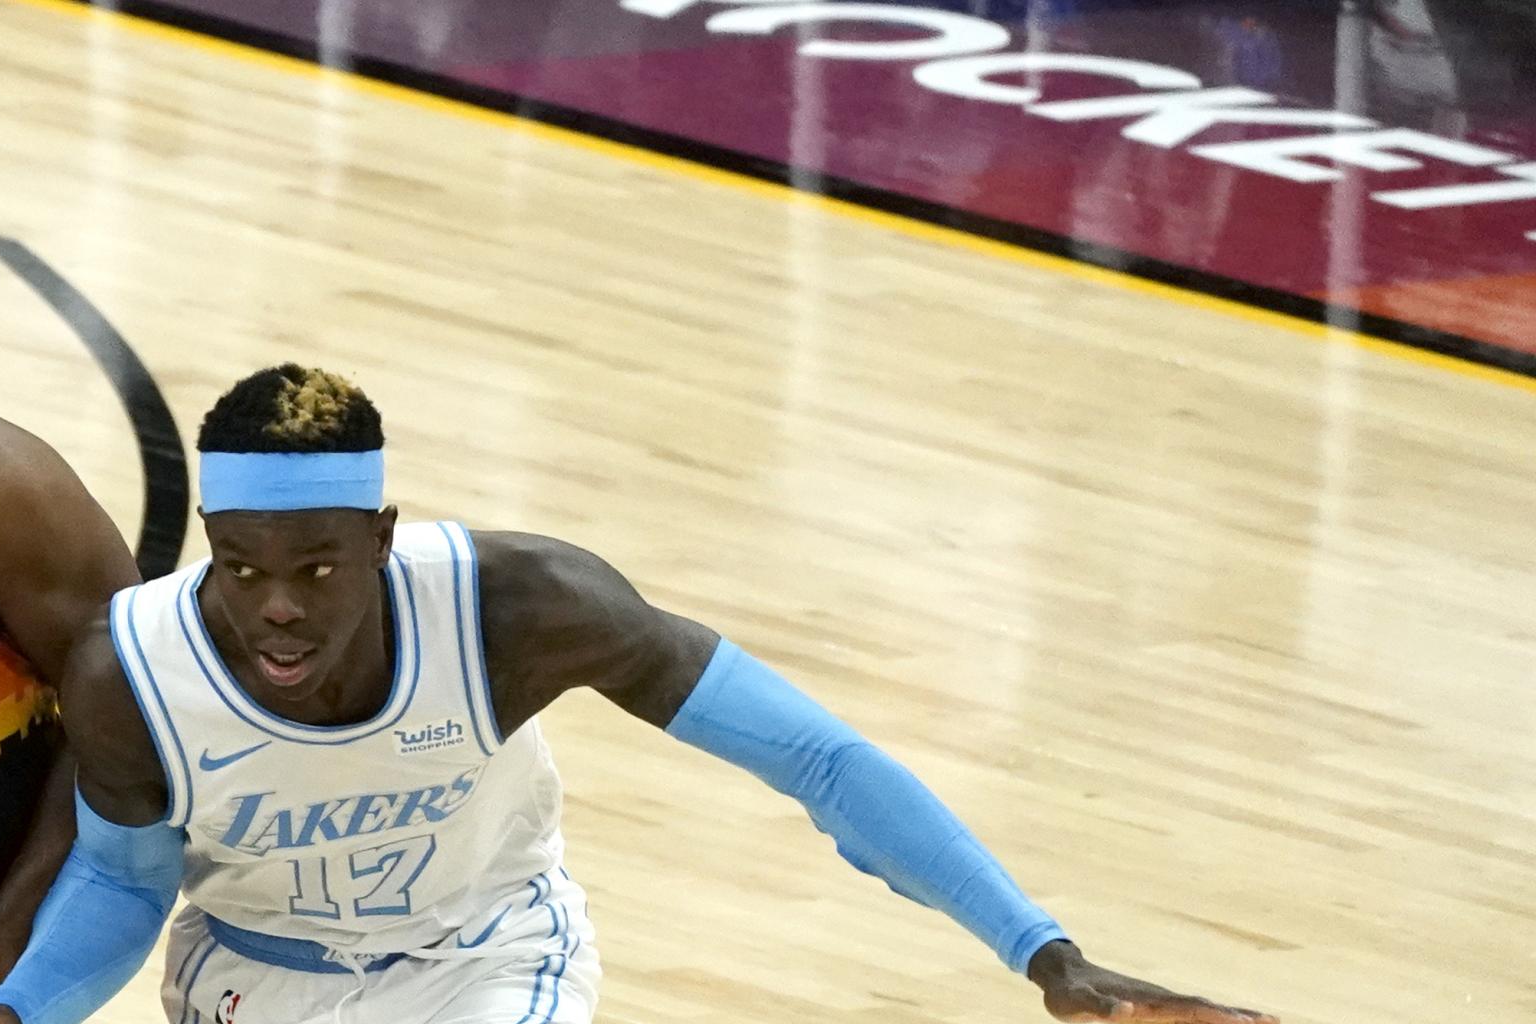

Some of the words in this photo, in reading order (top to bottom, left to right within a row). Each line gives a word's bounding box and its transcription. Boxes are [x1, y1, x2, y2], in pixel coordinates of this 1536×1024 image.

[619, 0, 1536, 210] OCKET
[394, 719, 463, 745] wish
[401, 737, 465, 753] SHOPPING
[219, 766, 479, 857] LAKERS
[285, 833, 437, 920] 17
